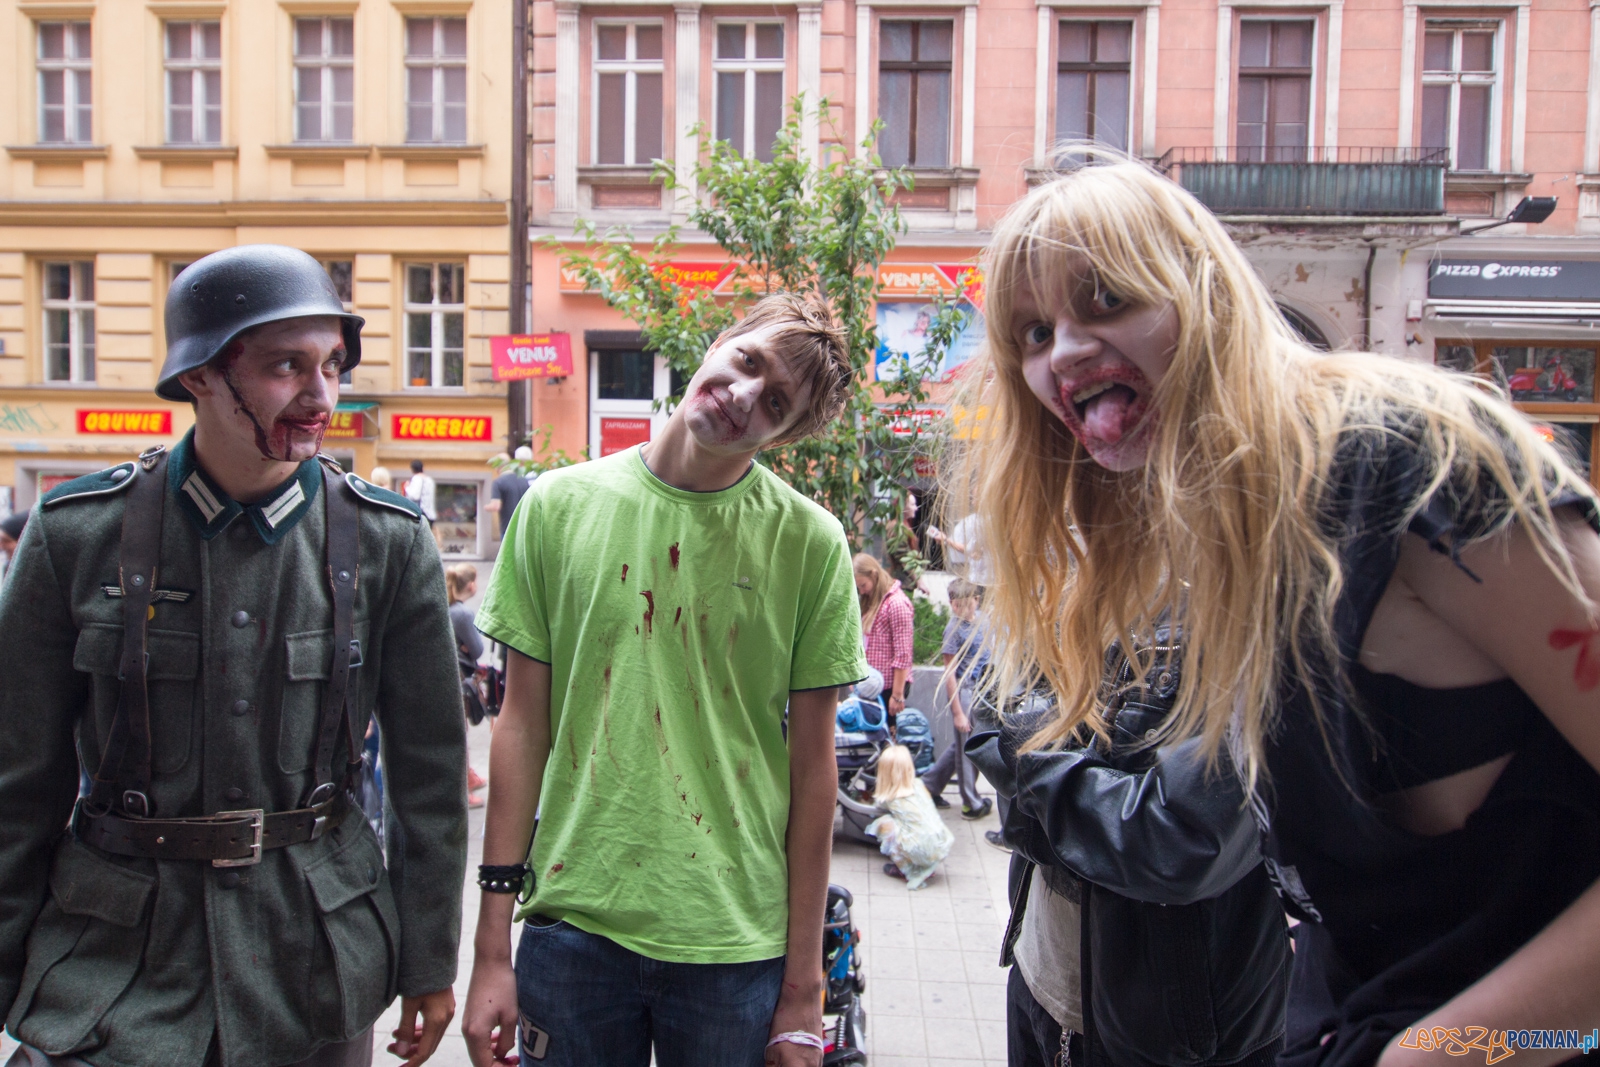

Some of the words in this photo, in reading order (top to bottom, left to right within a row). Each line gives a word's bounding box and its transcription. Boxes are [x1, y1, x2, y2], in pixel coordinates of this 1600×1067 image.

[507, 346, 557, 364] VENUS
[498, 366, 542, 378] Erotyczne
[85, 412, 163, 432] OBUWIE
[399, 417, 486, 438] TOREBKI
[604, 421, 646, 430] ZAPRASZAMY
